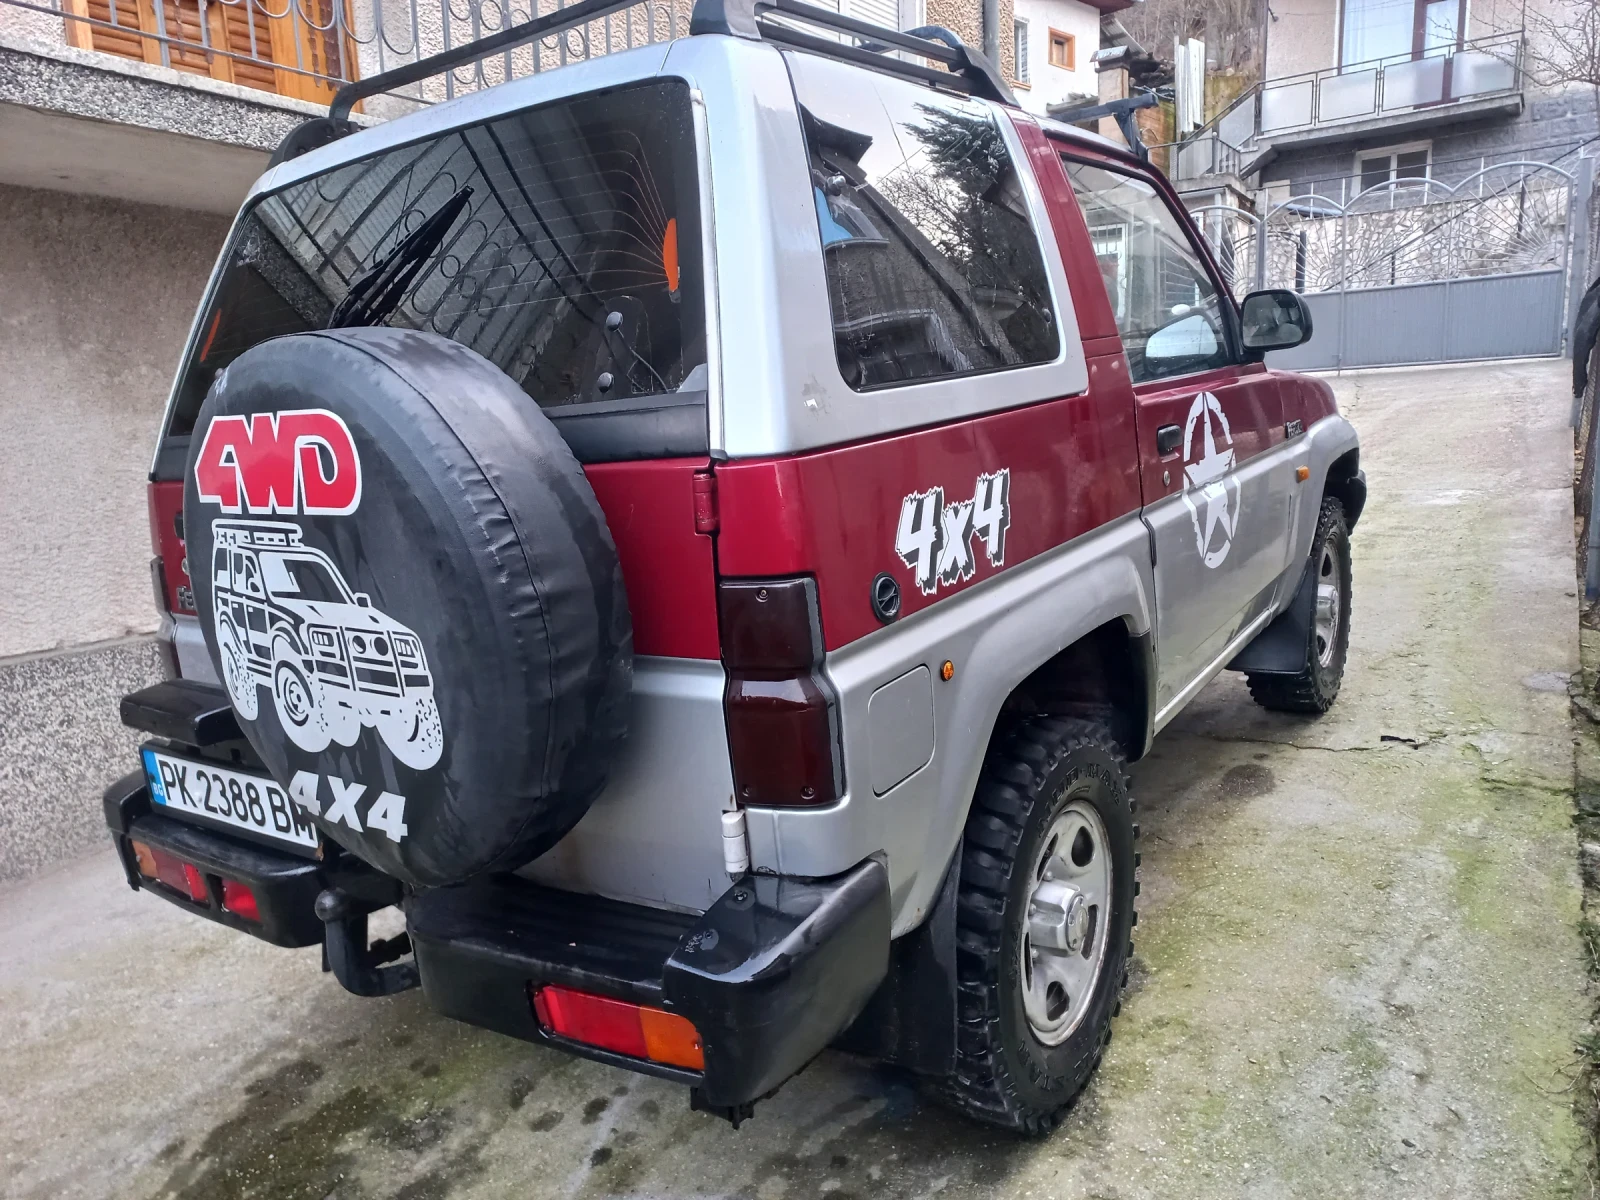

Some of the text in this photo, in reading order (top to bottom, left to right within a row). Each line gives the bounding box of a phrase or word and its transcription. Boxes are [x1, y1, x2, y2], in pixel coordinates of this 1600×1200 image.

[152, 782, 164, 796] BG
[158, 759, 315, 841] PK 2388 BM
[288, 769, 408, 843] 4X4
